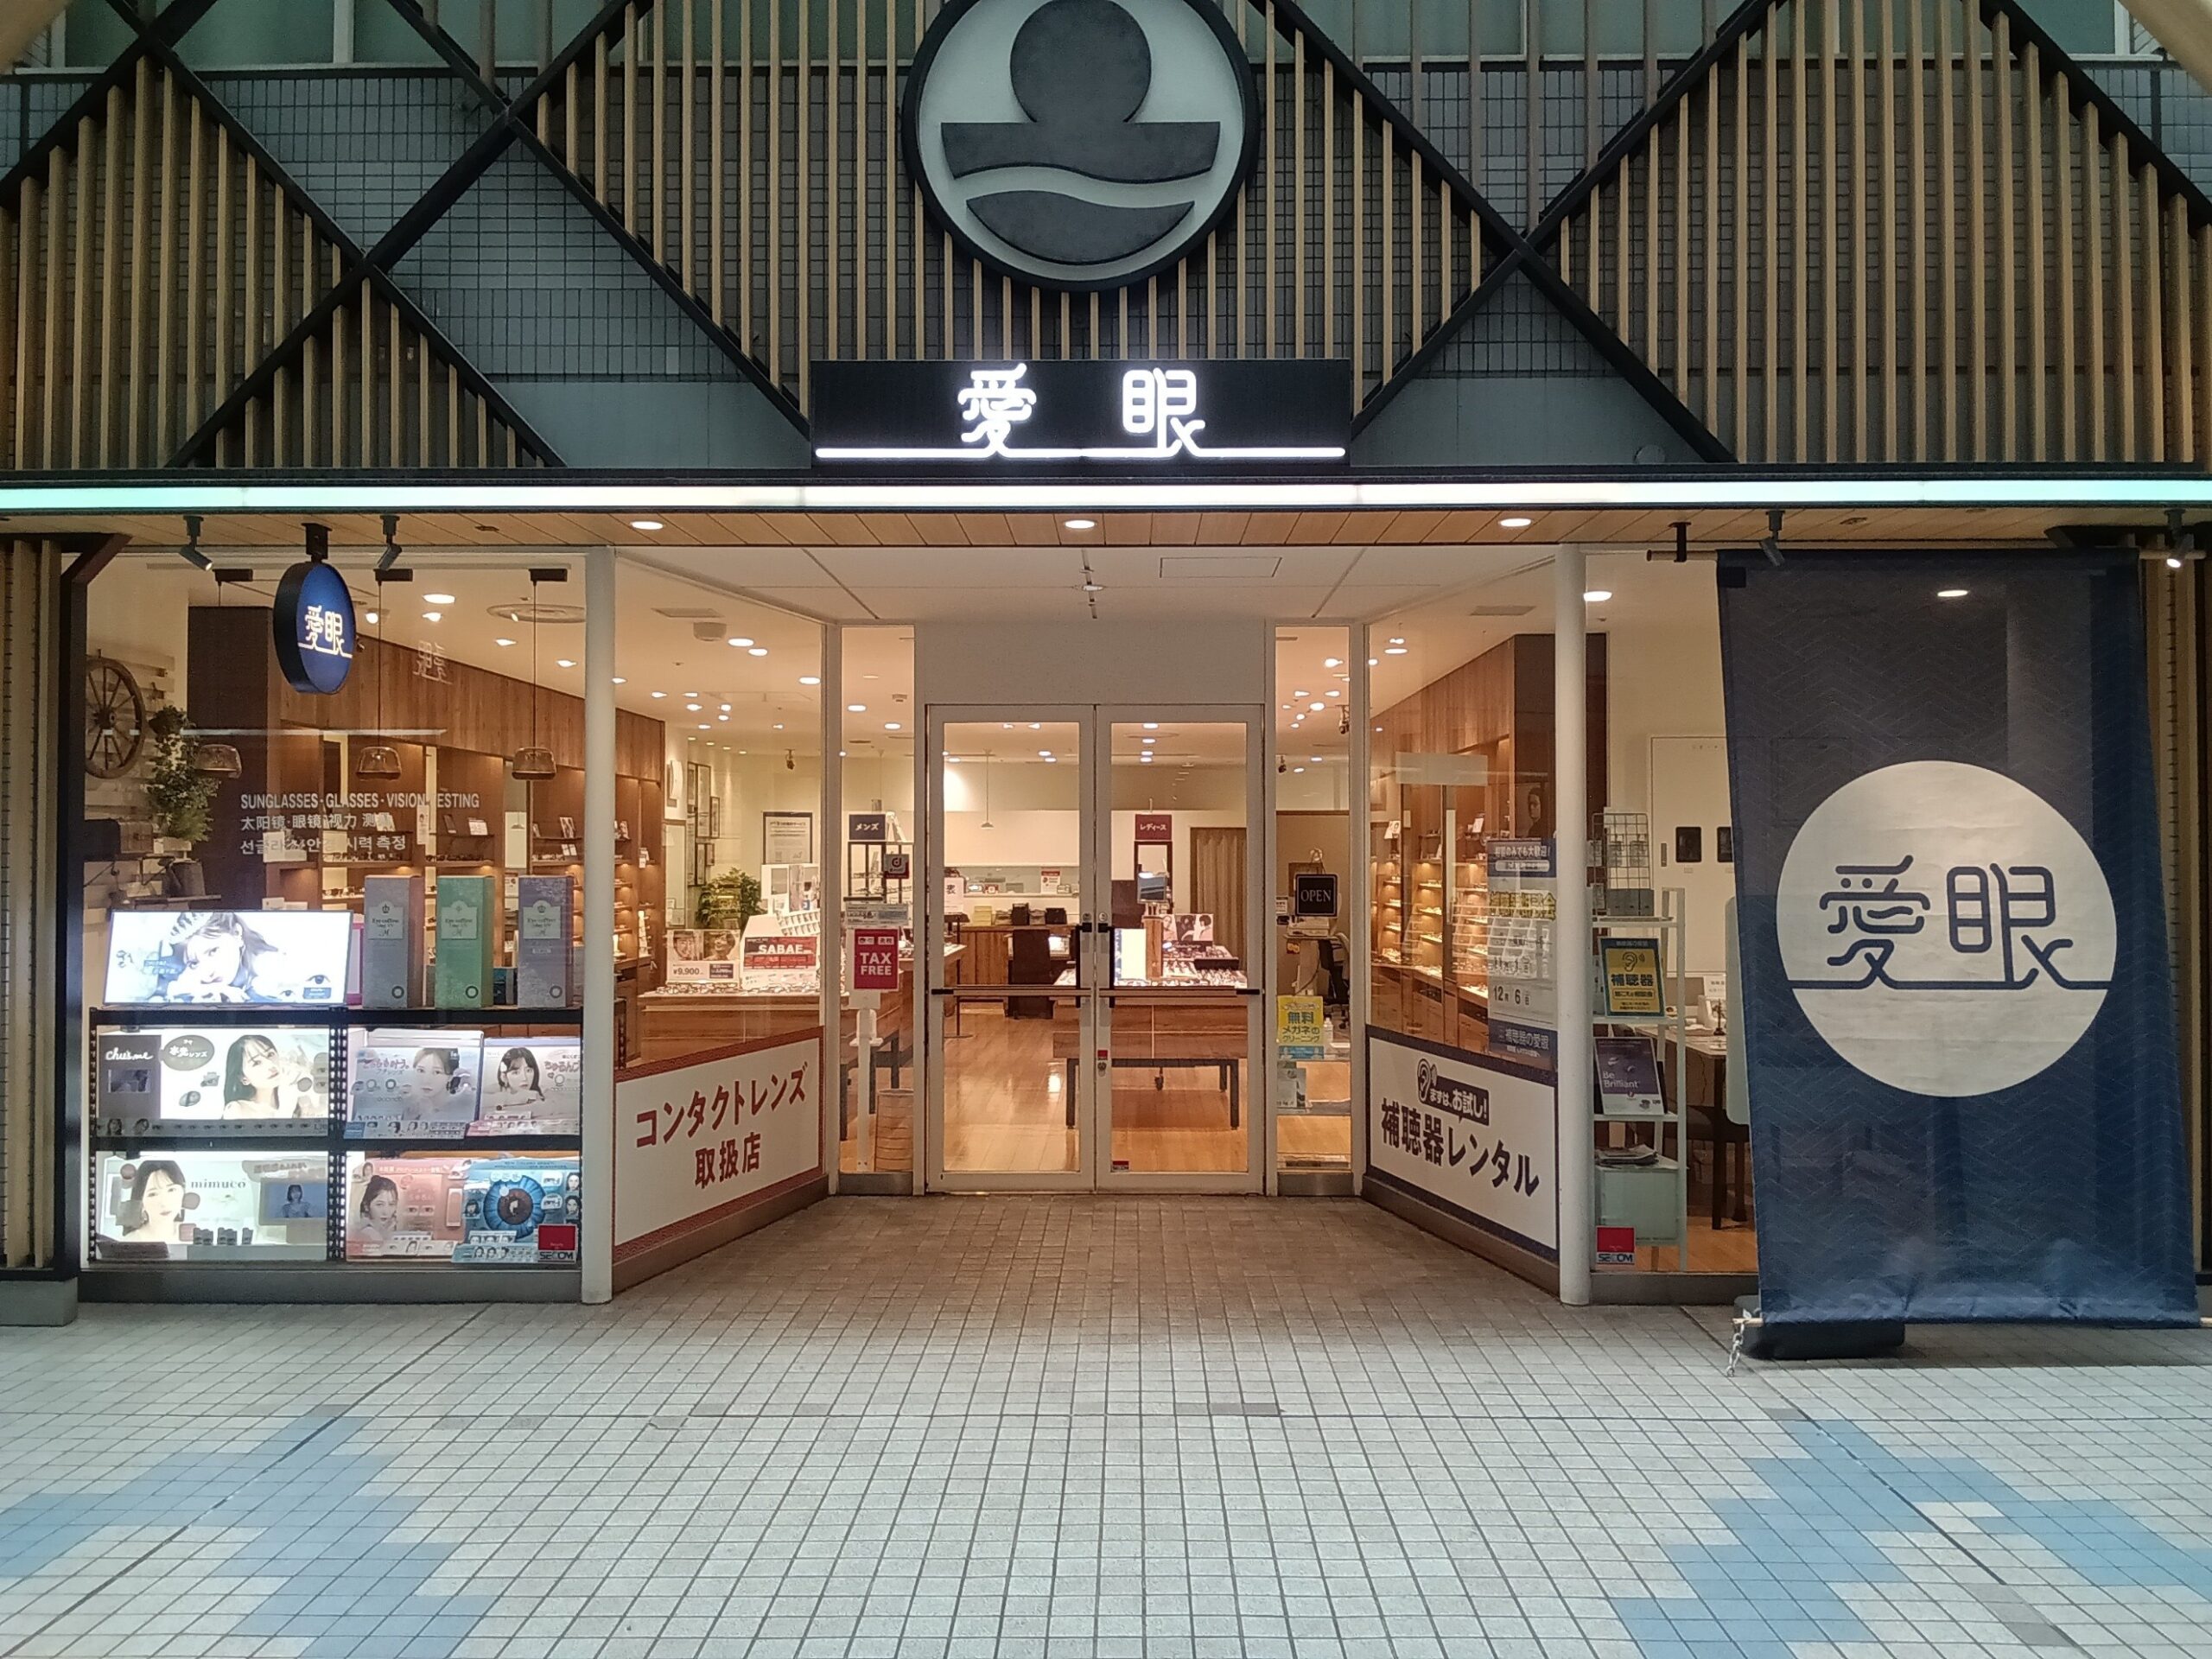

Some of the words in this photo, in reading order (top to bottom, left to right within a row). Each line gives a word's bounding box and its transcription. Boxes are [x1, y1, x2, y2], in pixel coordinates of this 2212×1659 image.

[956, 363, 1206, 458] 愛眼
[302, 605, 348, 657] 愛眼
[855, 823, 880, 831] メンズ
[376, 836, 406, 851] 측정
[1300, 889, 1332, 902] OPEN
[1815, 855, 2081, 990] 愛眼
[759, 944, 804, 955] SABAE
[860, 952, 892, 964] TAX
[861, 965, 892, 976] FREE
[1287, 1011, 1314, 1025] 無料
[1282, 1027, 1320, 1036] メガネの
[1604, 1079, 1638, 1089] Brilliant
[636, 1061, 808, 1147] コンタクトレンズ
[1381, 1098, 1540, 1198] 補聴器レンタル
[694, 1131, 761, 1189] 取扱店
[191, 1178, 246, 1189] mimuco
